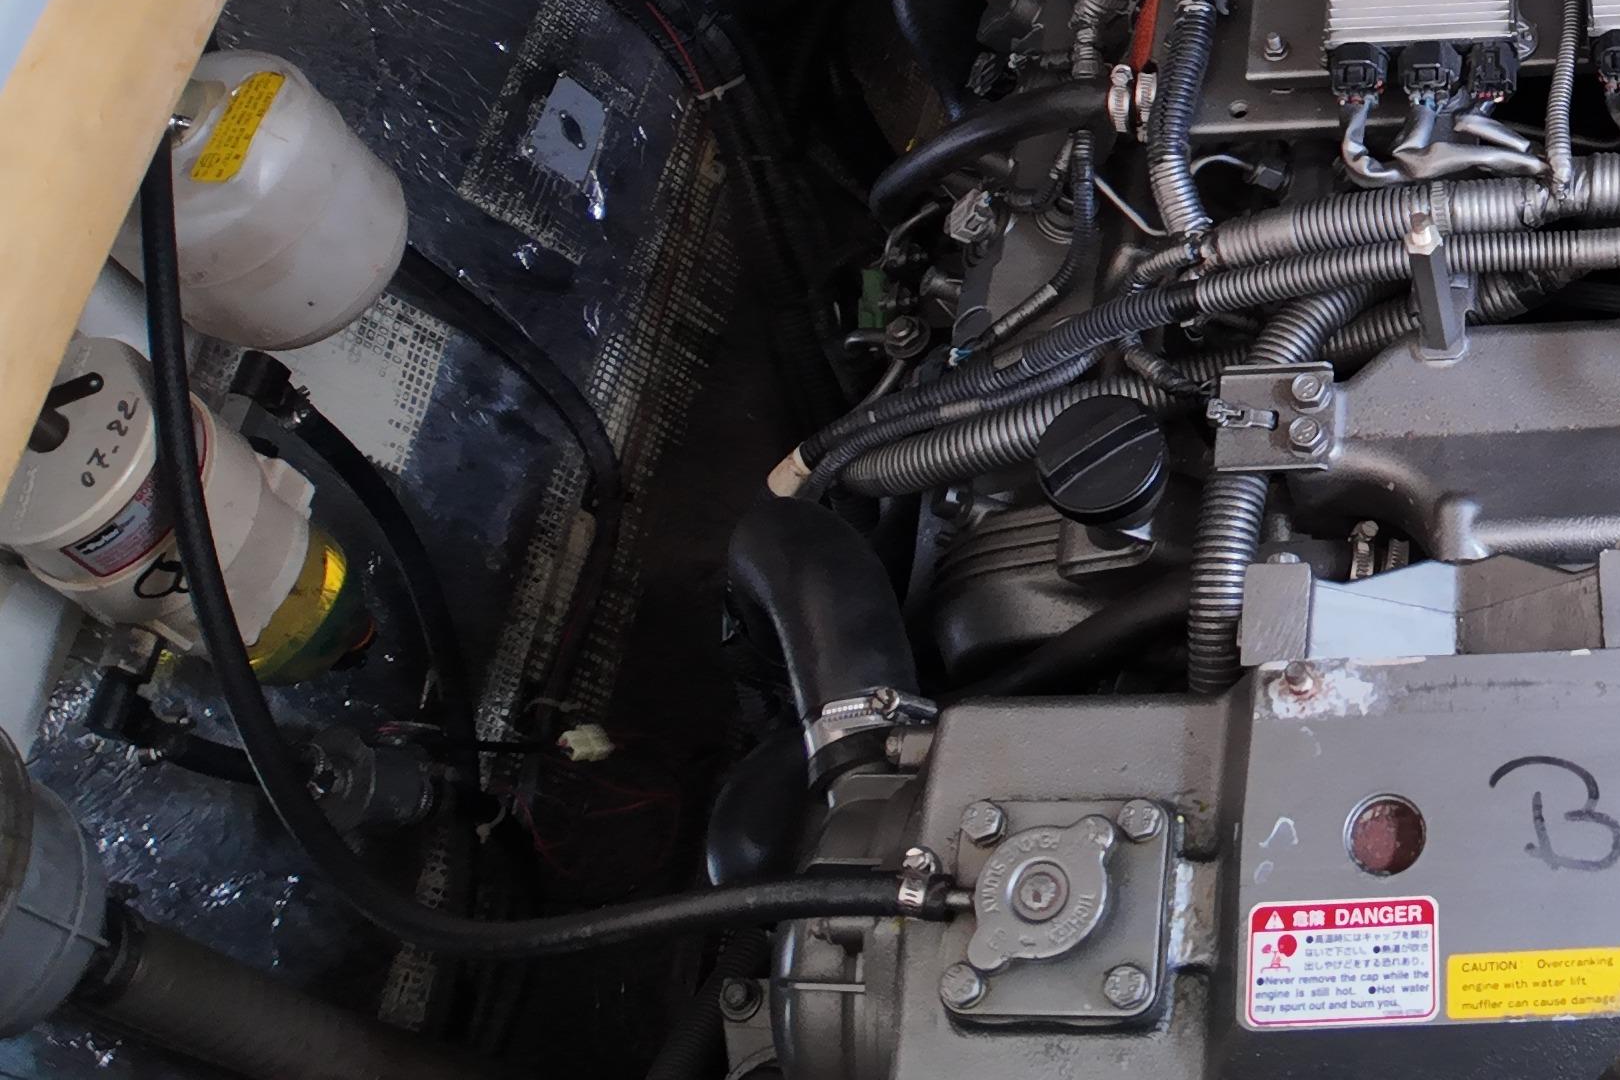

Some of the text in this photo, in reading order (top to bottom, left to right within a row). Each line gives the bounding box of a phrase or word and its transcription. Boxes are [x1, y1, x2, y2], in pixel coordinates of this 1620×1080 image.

[1335, 905, 1422, 926] DANGER
[1537, 956, 1614, 969] Overcranking
[1265, 969, 1430, 985] Never remove the cap while the
[1461, 975, 1587, 993] engine with water lift
[1256, 989, 1290, 1001] engine
[1295, 988, 1305, 998] is
[1311, 987, 1330, 997] still
[1376, 984, 1395, 995] Hot
[1402, 983, 1430, 993] water
[1255, 1004, 1276, 1015] may
[1279, 1002, 1306, 1014] spurt
[1309, 1001, 1325, 1011] out
[1328, 999, 1348, 1010] and
[1351, 998, 1375, 1010] burn
[1461, 999, 1503, 1010] muffler
[1508, 999, 1529, 1008] can
[1533, 997, 1567, 1007] cause
